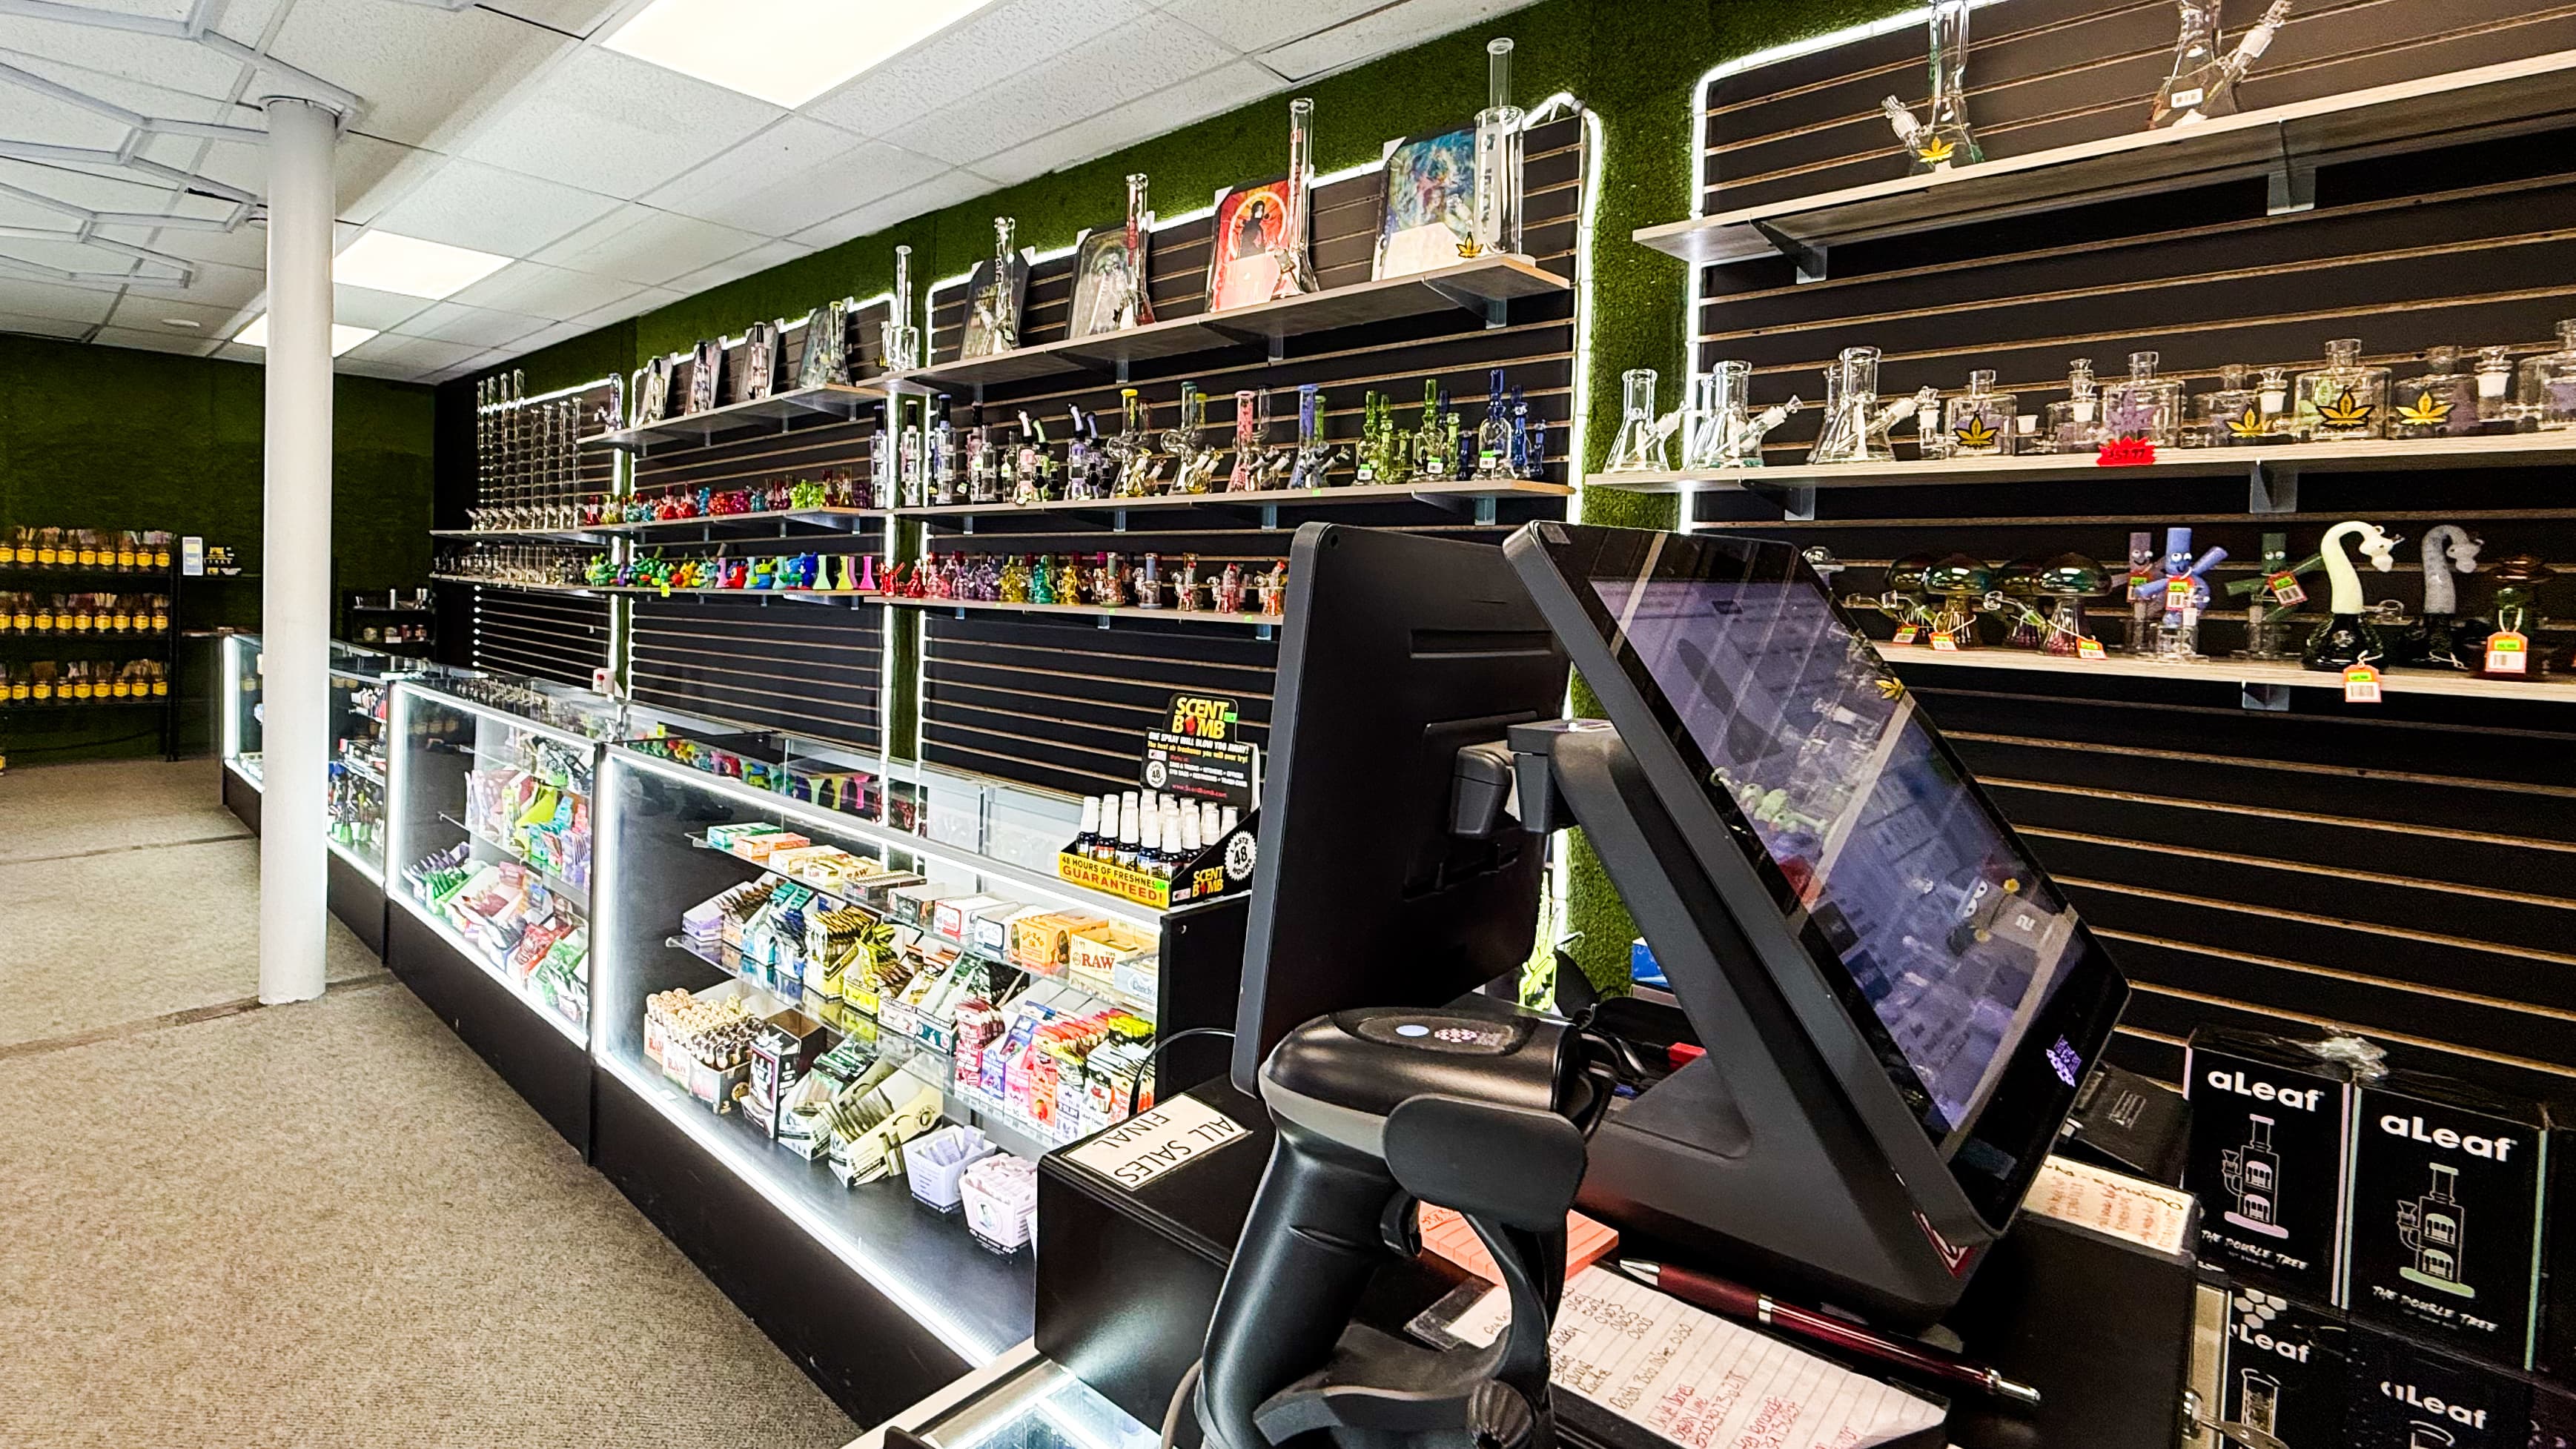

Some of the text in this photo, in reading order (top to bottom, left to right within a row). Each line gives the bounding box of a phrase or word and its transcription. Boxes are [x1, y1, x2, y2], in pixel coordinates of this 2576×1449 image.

[1175, 697, 1229, 720] SCENT
[1161, 733, 1179, 744] SPRAY
[1196, 737, 1213, 749] BLOW
[1152, 769, 1161, 779] 48
[1234, 846, 1248, 865] 48
[1062, 858, 1157, 890] 48 HOURS OF FRESHNES
[1062, 866, 1164, 903] GUARANTEED!
[1193, 866, 1224, 884] SCENT
[1082, 953, 1115, 971] RAW
[2208, 1070, 2321, 1112] aLeaf
[1093, 1112, 1171, 1149] FINAL
[2380, 1115, 2512, 1162] aLeaf
[1114, 1116, 1236, 1183] ALL SALES
[2201, 1229, 2223, 1243] THE
[2275, 1253, 2309, 1270] TREE
[2372, 1285, 2398, 1300] THE
[2460, 1313, 2499, 1332] TREE
